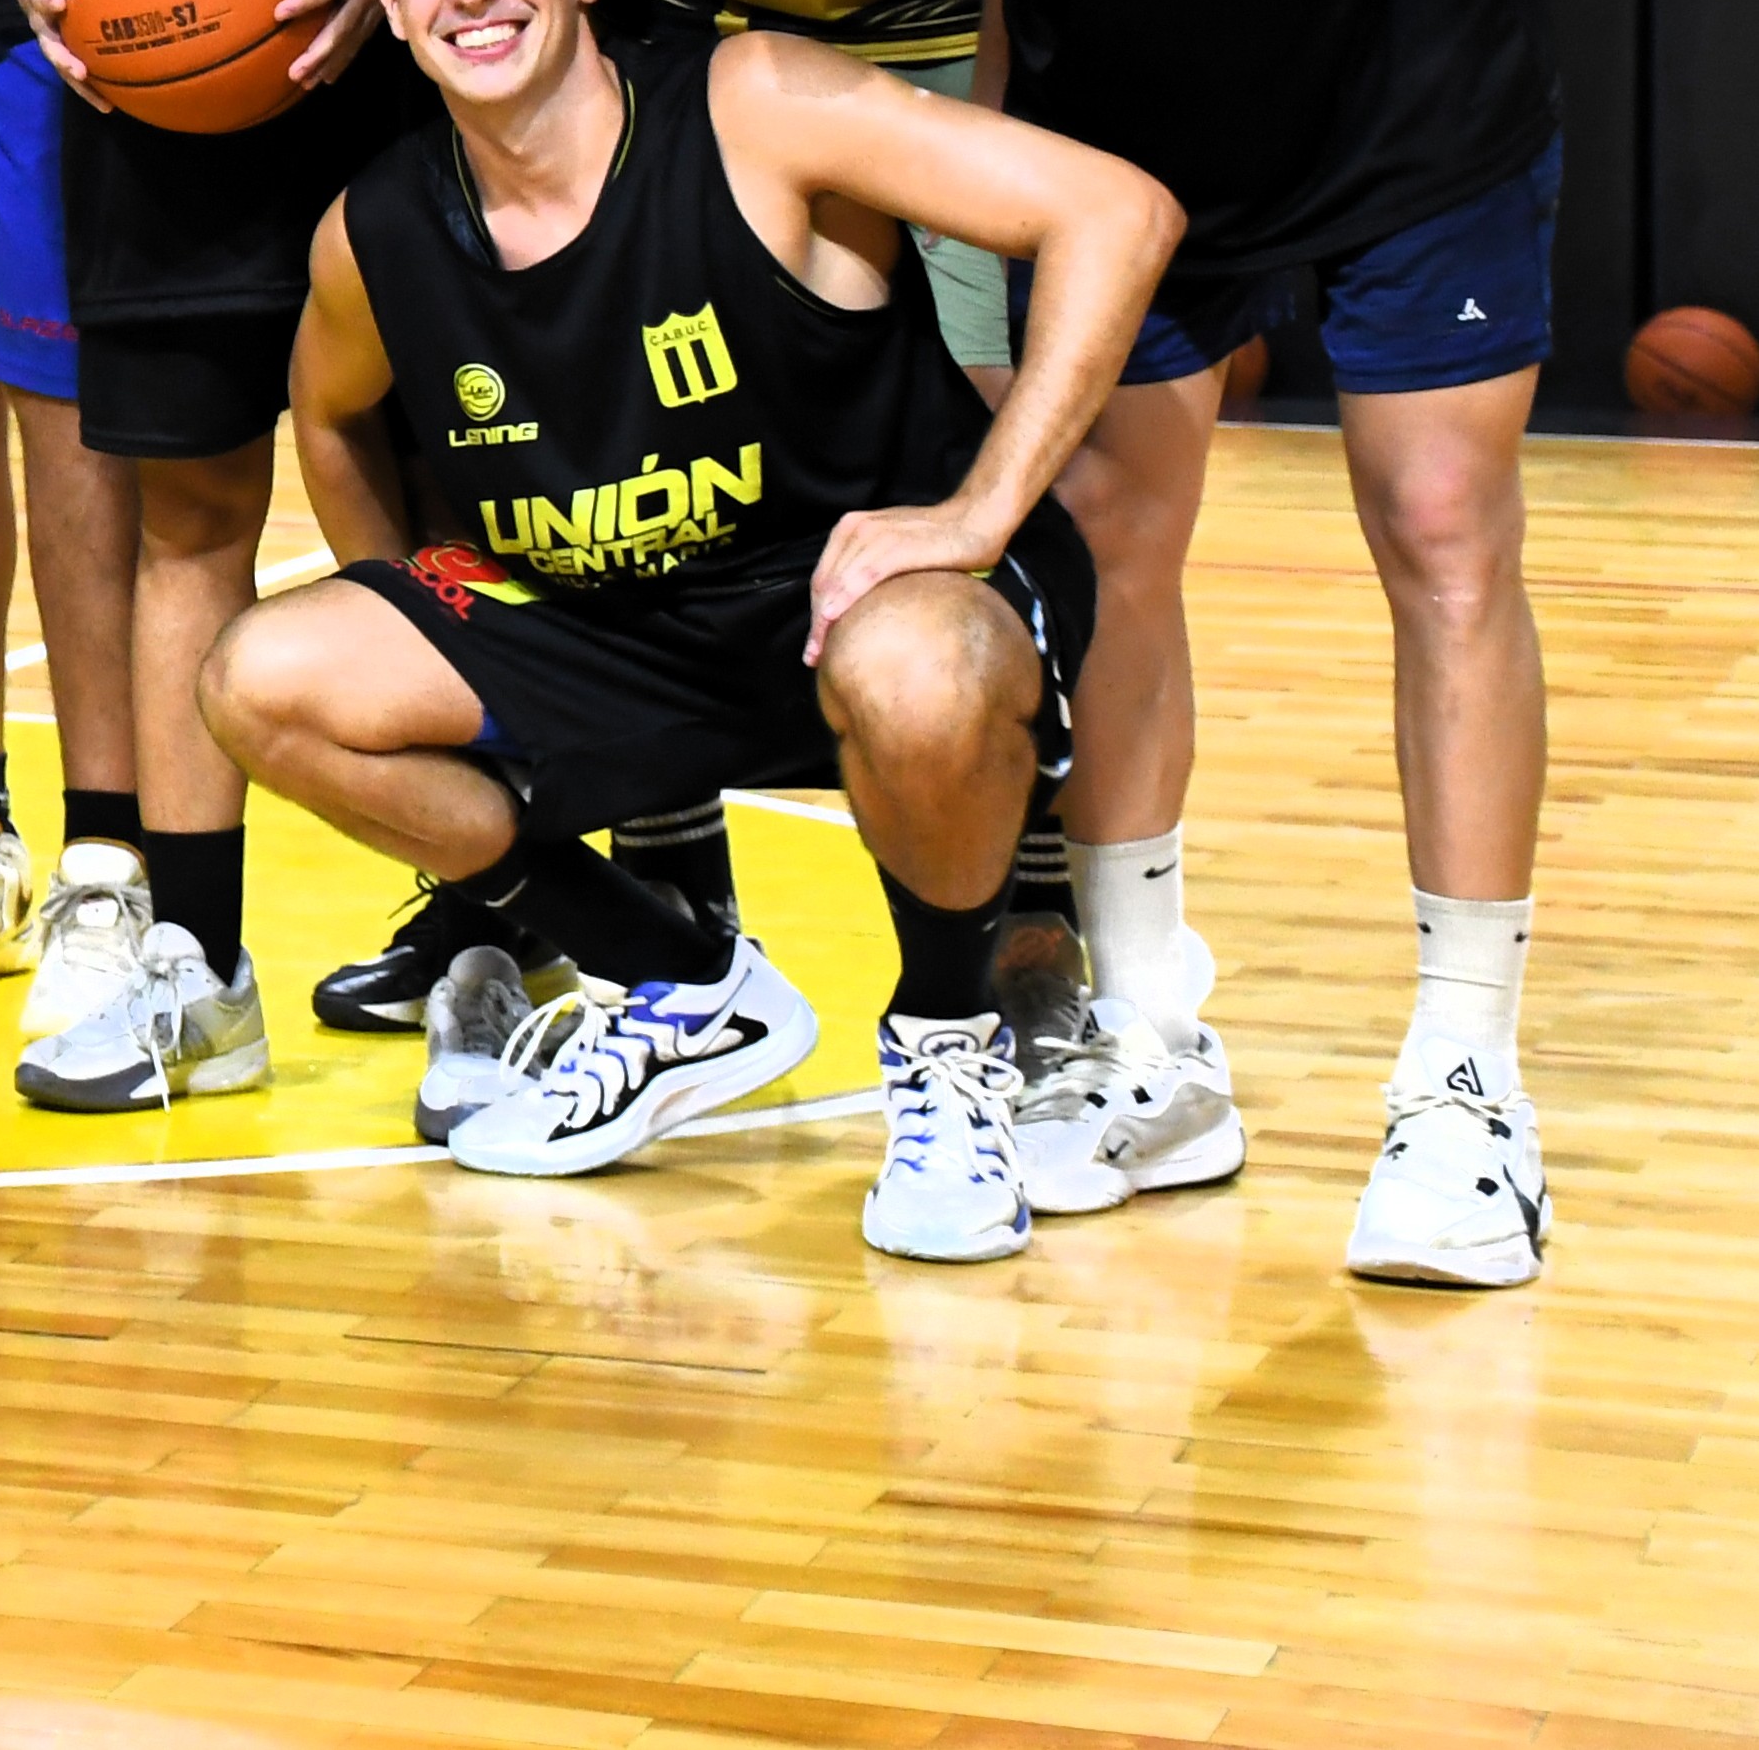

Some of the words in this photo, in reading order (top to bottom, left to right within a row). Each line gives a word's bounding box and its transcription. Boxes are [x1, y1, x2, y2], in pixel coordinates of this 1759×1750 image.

[448, 421, 539, 448] LENING
[478, 441, 763, 556] UNIÓN
[526, 509, 737, 577] CENTRAL
